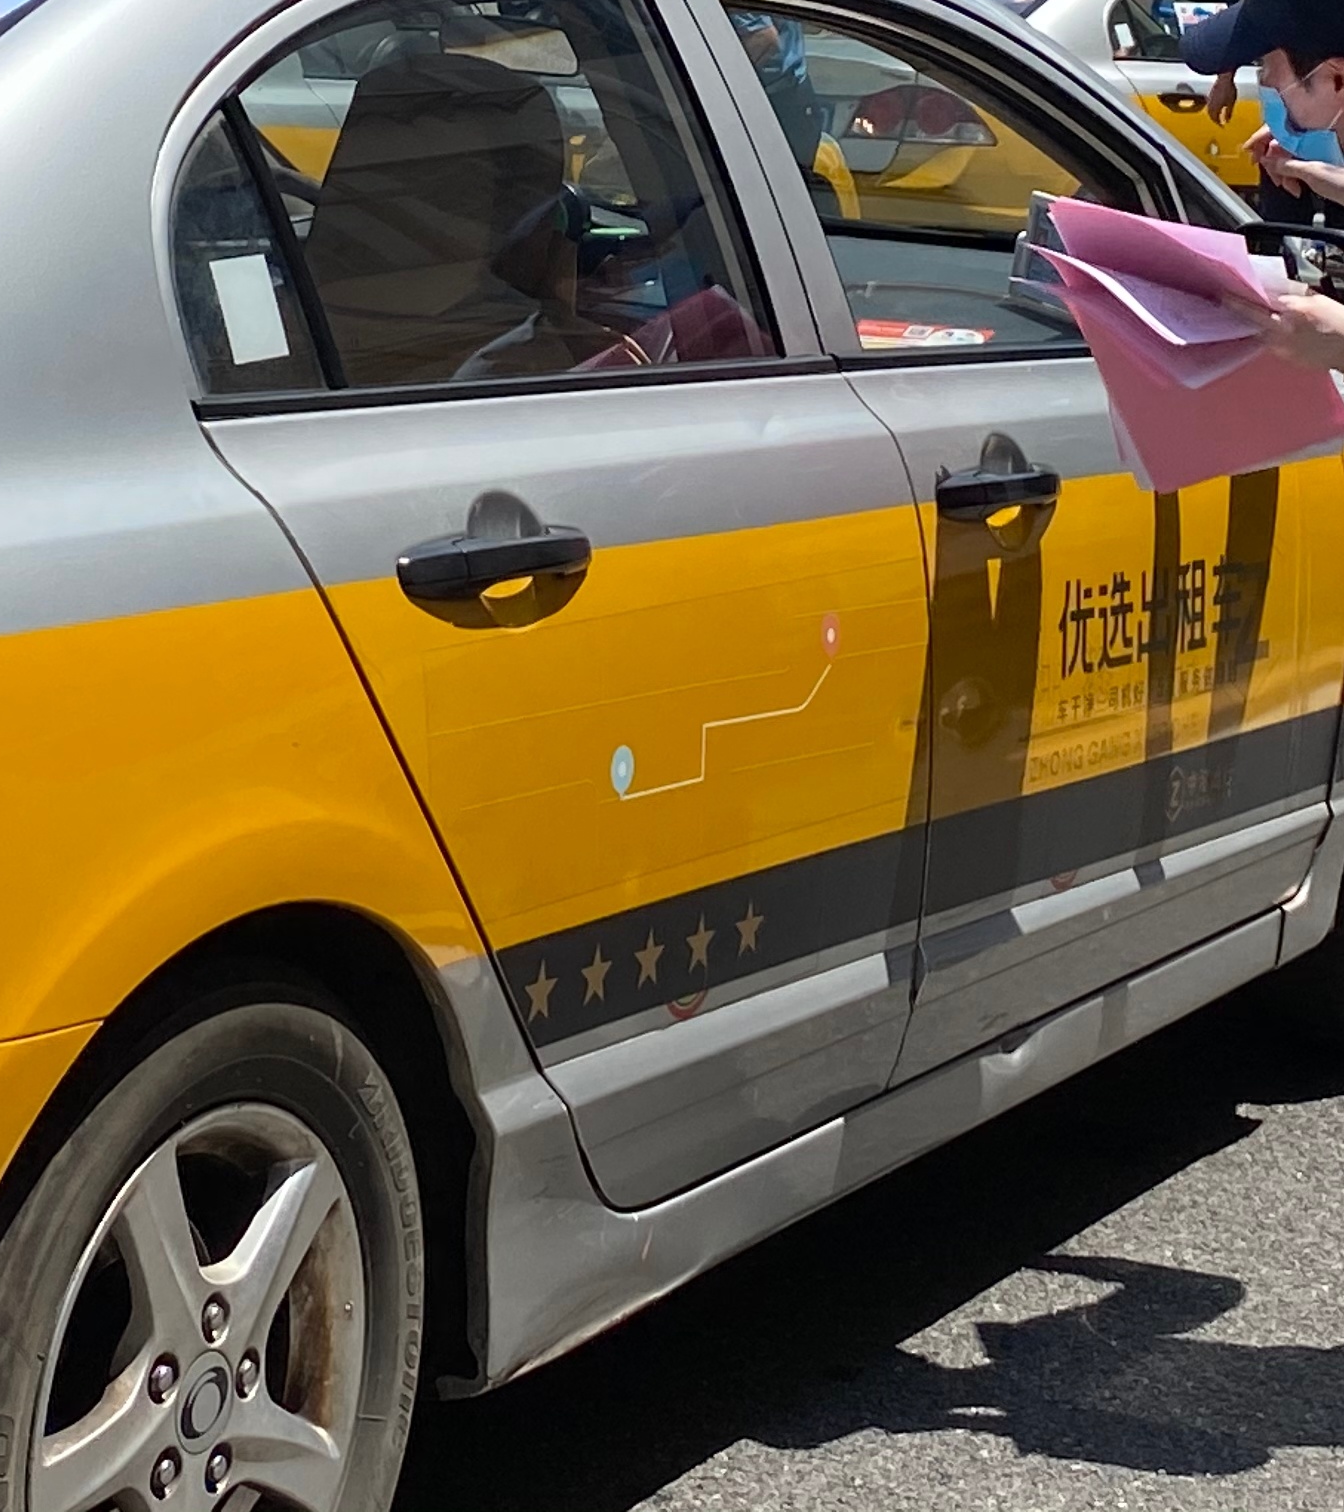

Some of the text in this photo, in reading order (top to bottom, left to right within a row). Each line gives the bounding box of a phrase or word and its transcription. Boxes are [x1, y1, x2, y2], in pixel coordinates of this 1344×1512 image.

[1059, 555, 1248, 681] 优选出租车
